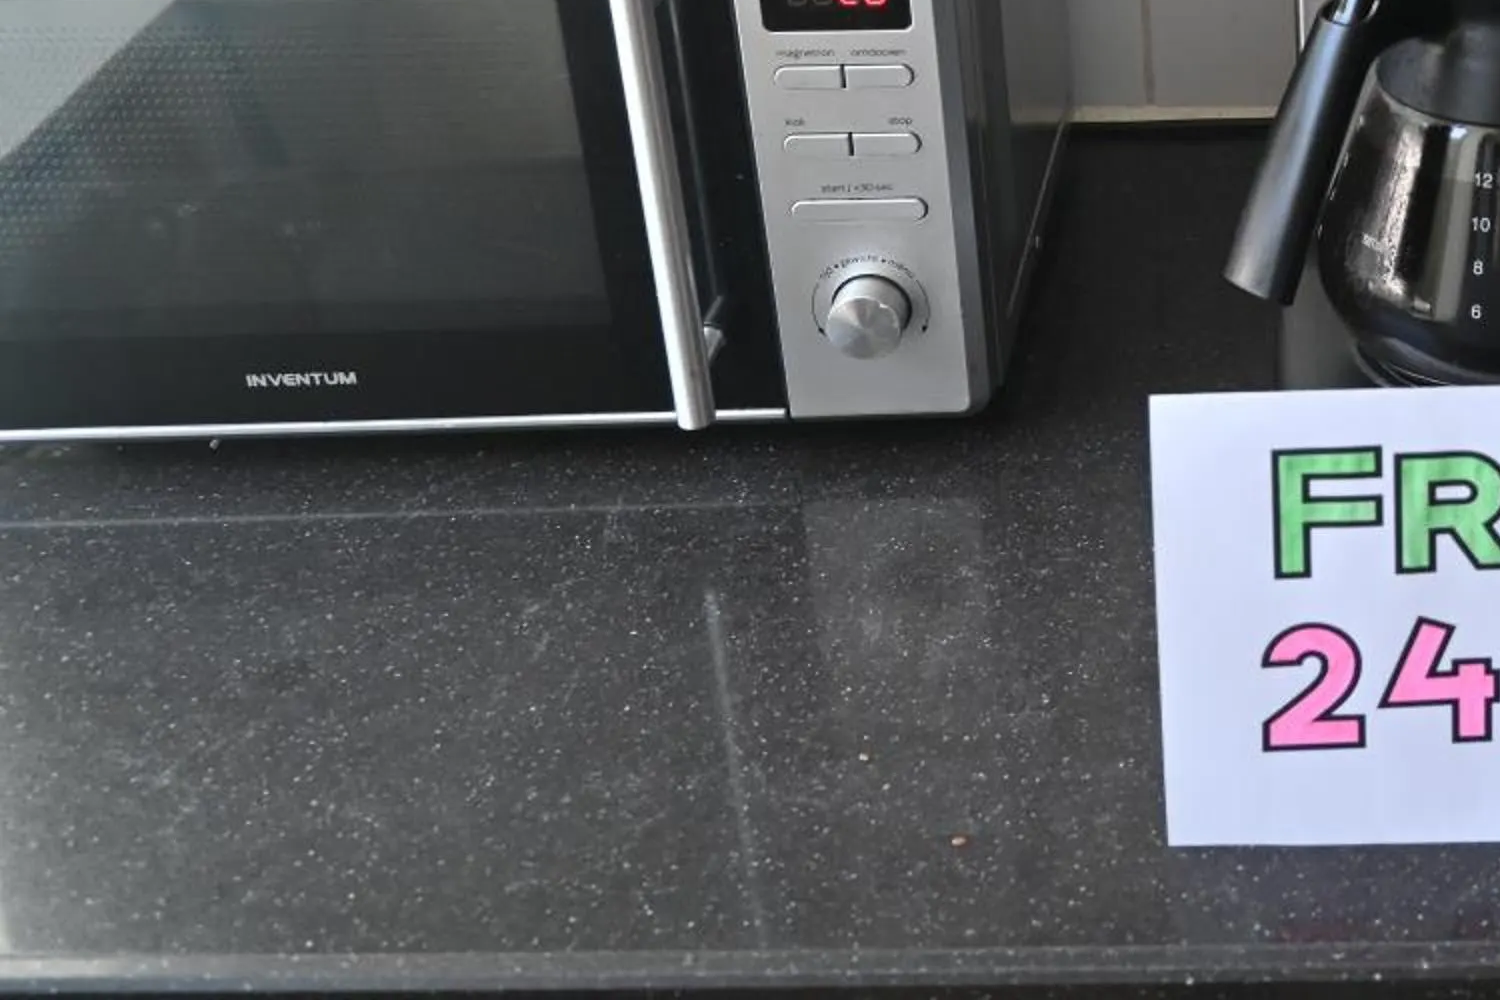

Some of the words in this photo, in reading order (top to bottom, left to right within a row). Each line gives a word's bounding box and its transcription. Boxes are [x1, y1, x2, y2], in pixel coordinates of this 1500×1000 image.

[1475, 172, 1493, 189] 12
[1472, 216, 1491, 233] 10
[1473, 259, 1484, 276] 8
[1471, 304, 1482, 320] 6
[246, 371, 357, 387] INVENTUM
